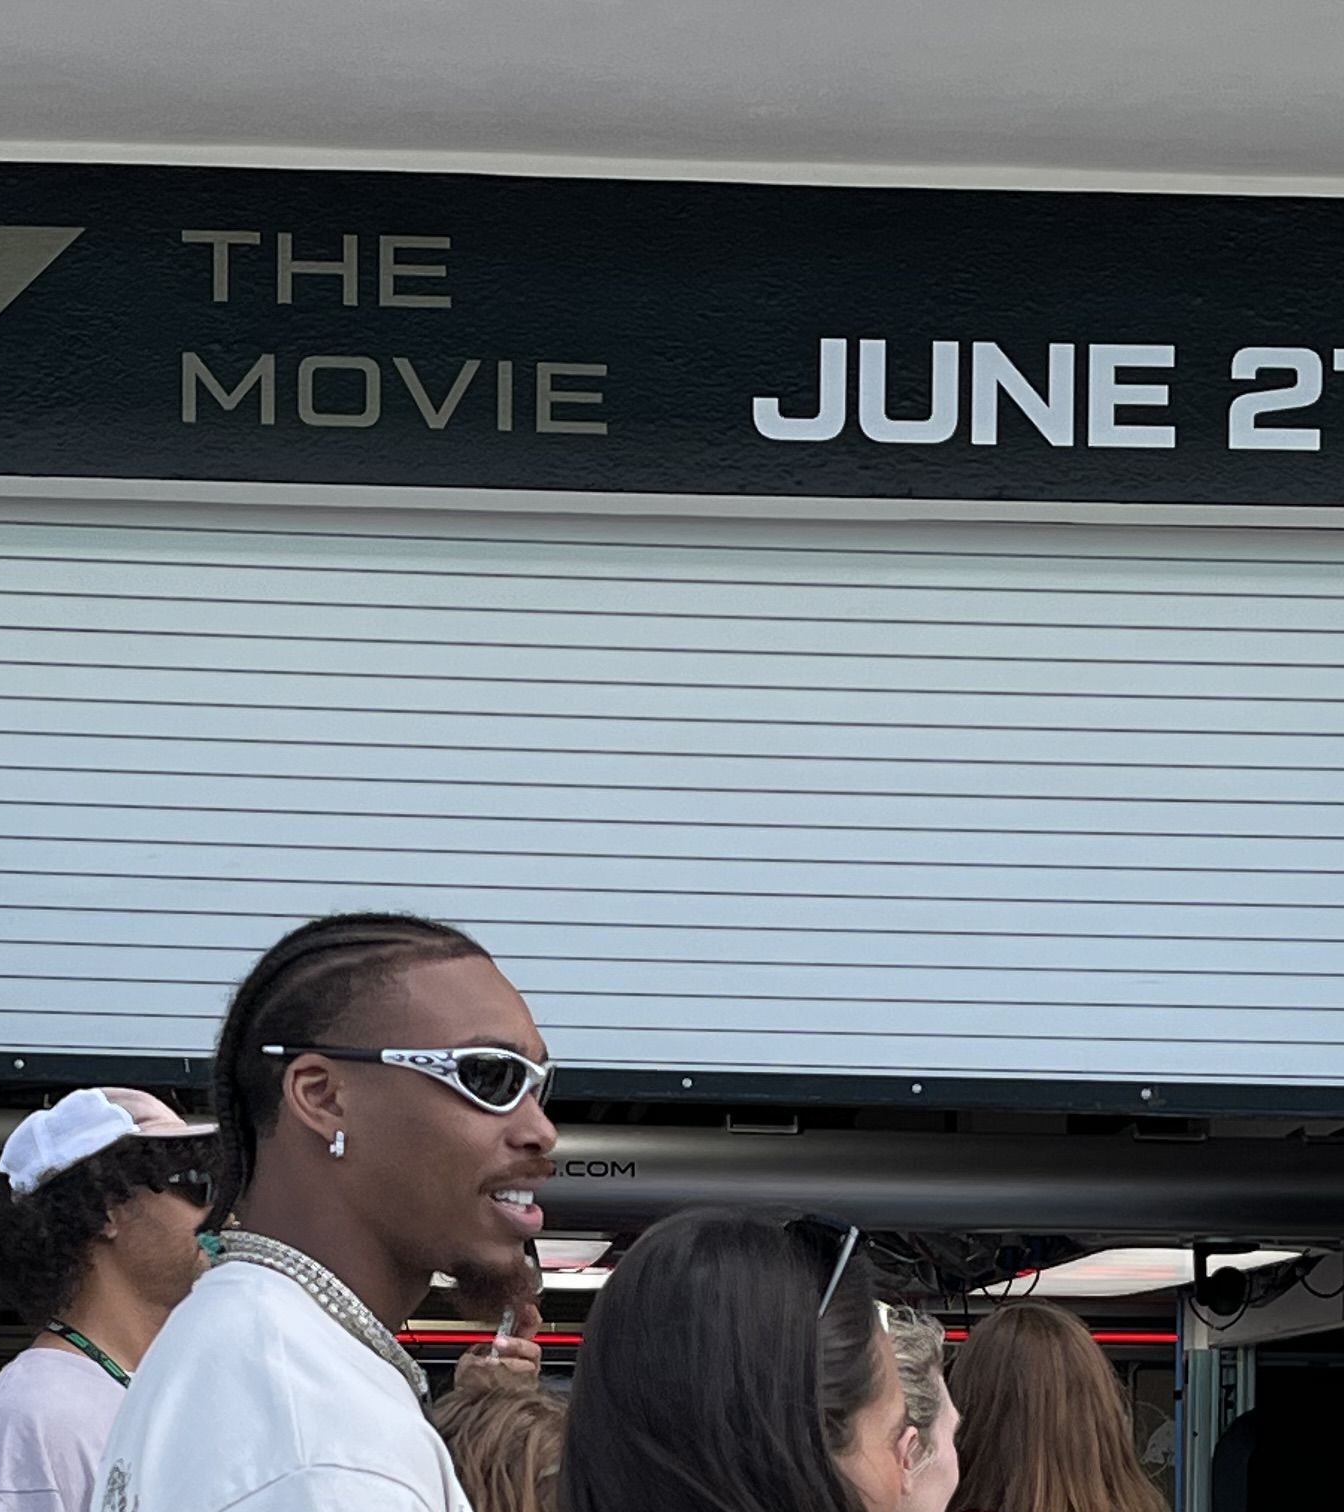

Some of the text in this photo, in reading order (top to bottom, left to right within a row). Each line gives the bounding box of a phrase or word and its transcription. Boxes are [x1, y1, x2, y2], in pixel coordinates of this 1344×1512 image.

[181, 229, 452, 308] THE
[181, 351, 609, 435] MOVIE
[752, 337, 1176, 448] JUNE
